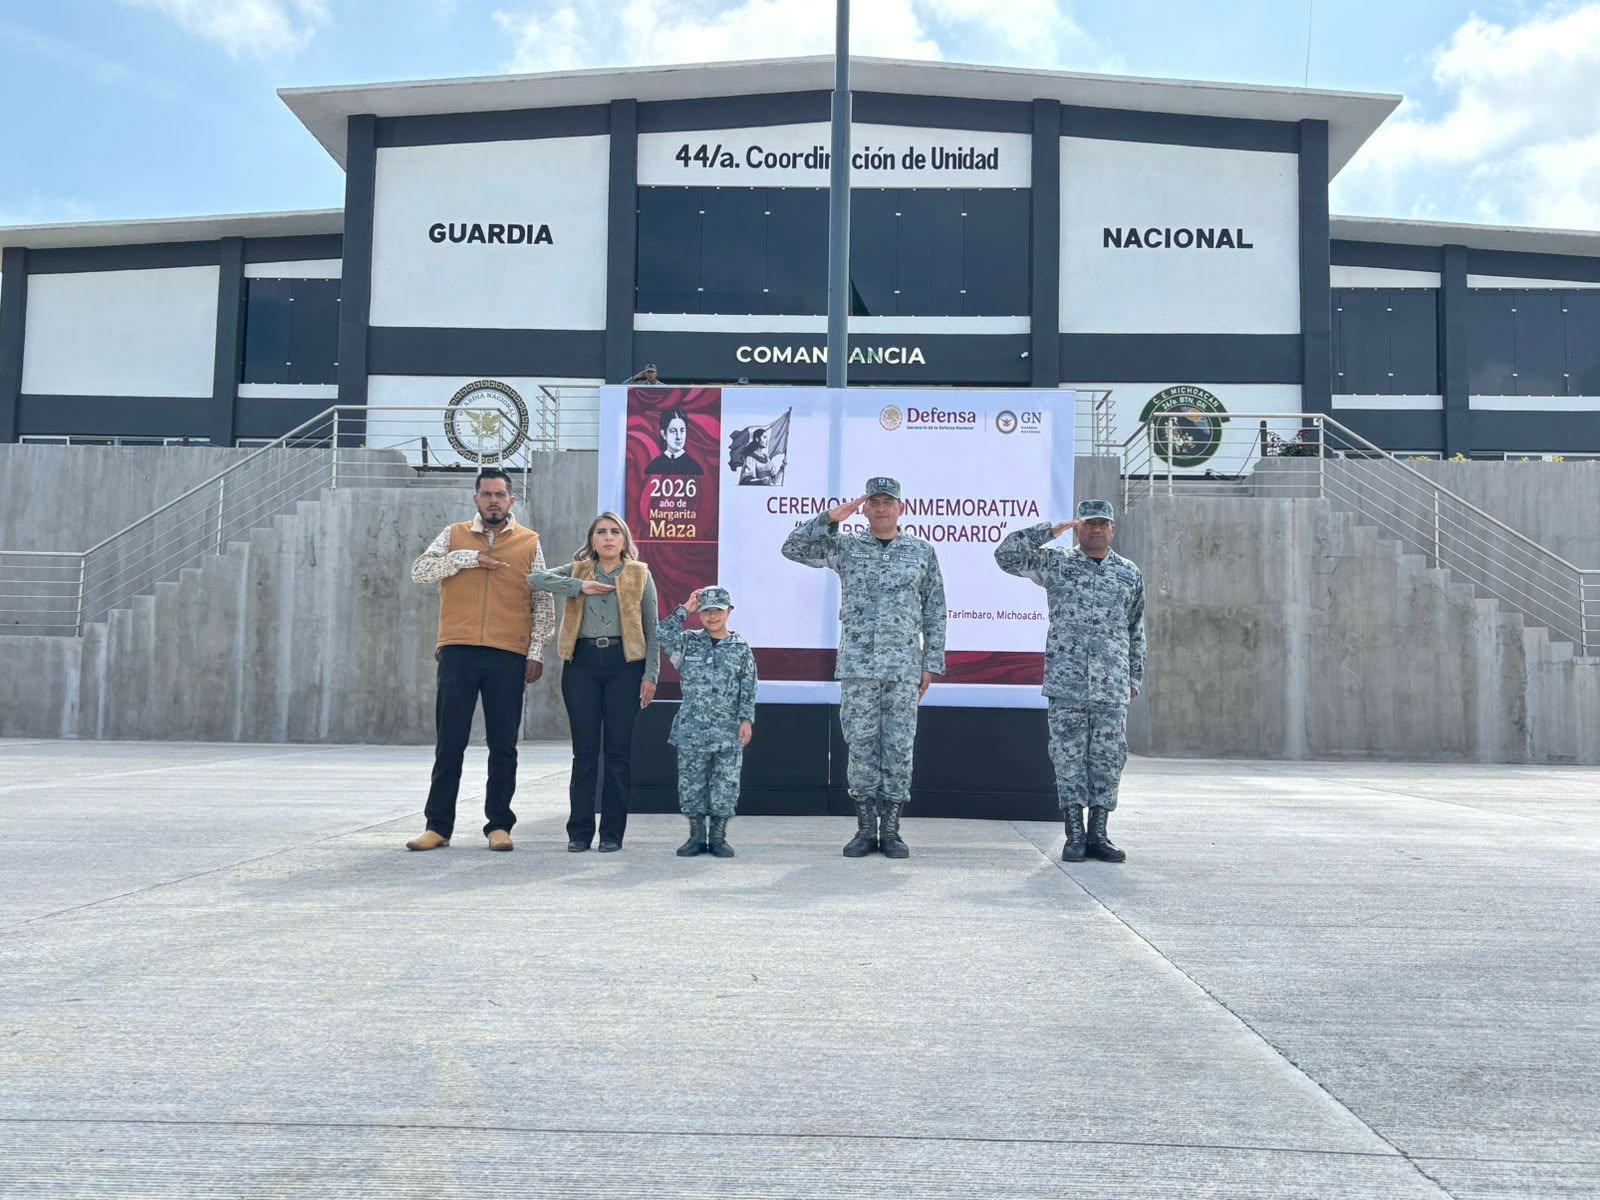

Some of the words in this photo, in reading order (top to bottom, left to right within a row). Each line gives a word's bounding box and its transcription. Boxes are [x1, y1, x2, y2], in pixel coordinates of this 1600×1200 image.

[675, 143, 740, 168] 44/a.
[901, 146, 926, 170] de
[931, 147, 999, 170] Unidad
[428, 223, 553, 245] GUARDIA
[1103, 227, 1253, 249] NACIONAL
[736, 345, 926, 365] COMANANCIA
[907, 406, 976, 424] Defensa
[1021, 411, 1042, 424] GN
[650, 479, 697, 498] 2026
[658, 499, 675, 508] año
[676, 499, 687, 508] de
[649, 509, 697, 521] Margarita
[649, 520, 697, 538] Maza
[947, 608, 994, 621] Tarímbaro,
[996, 609, 1046, 621] Michoacán.
